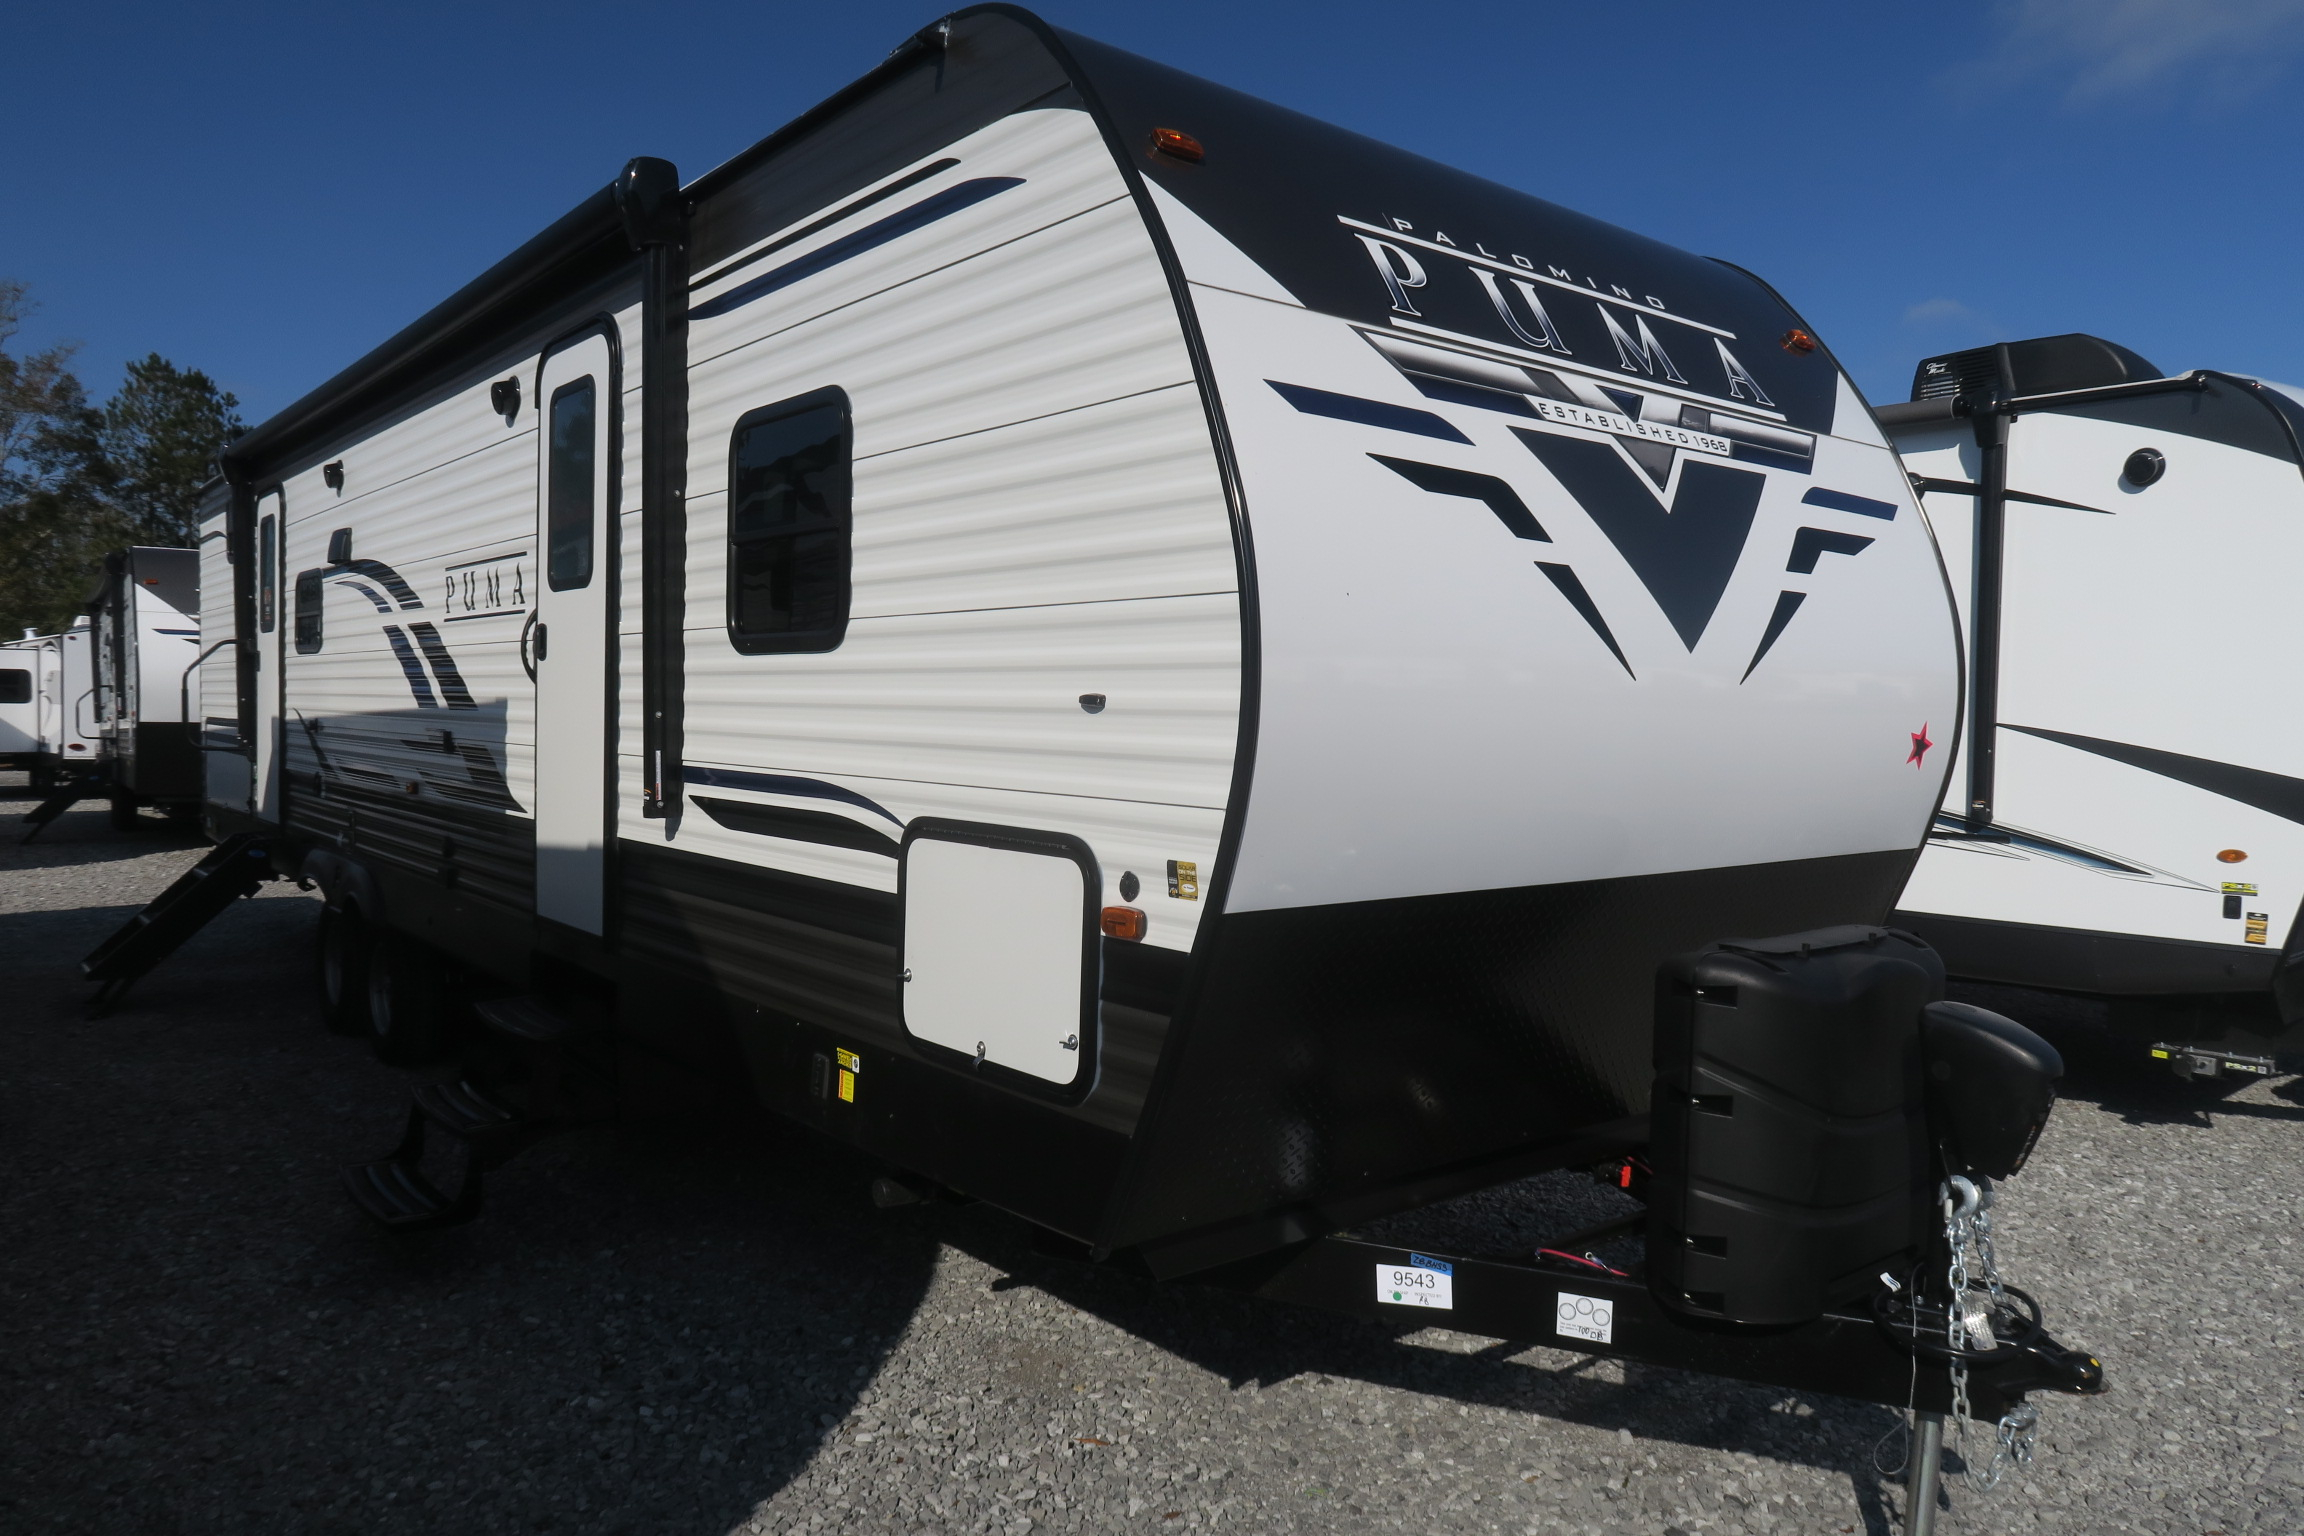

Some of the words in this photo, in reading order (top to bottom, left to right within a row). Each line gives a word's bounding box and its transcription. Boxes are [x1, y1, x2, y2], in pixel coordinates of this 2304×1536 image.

[1392, 217, 1666, 310] PALOMINO
[1353, 232, 1776, 407] PUMA
[1538, 402, 1689, 444] ESTABLISHED
[1693, 435, 1728, 452] 1968
[445, 561, 526, 614] PUMA
[1179, 874, 1197, 882] SIDE
[1393, 1271, 1435, 1289] 9543
